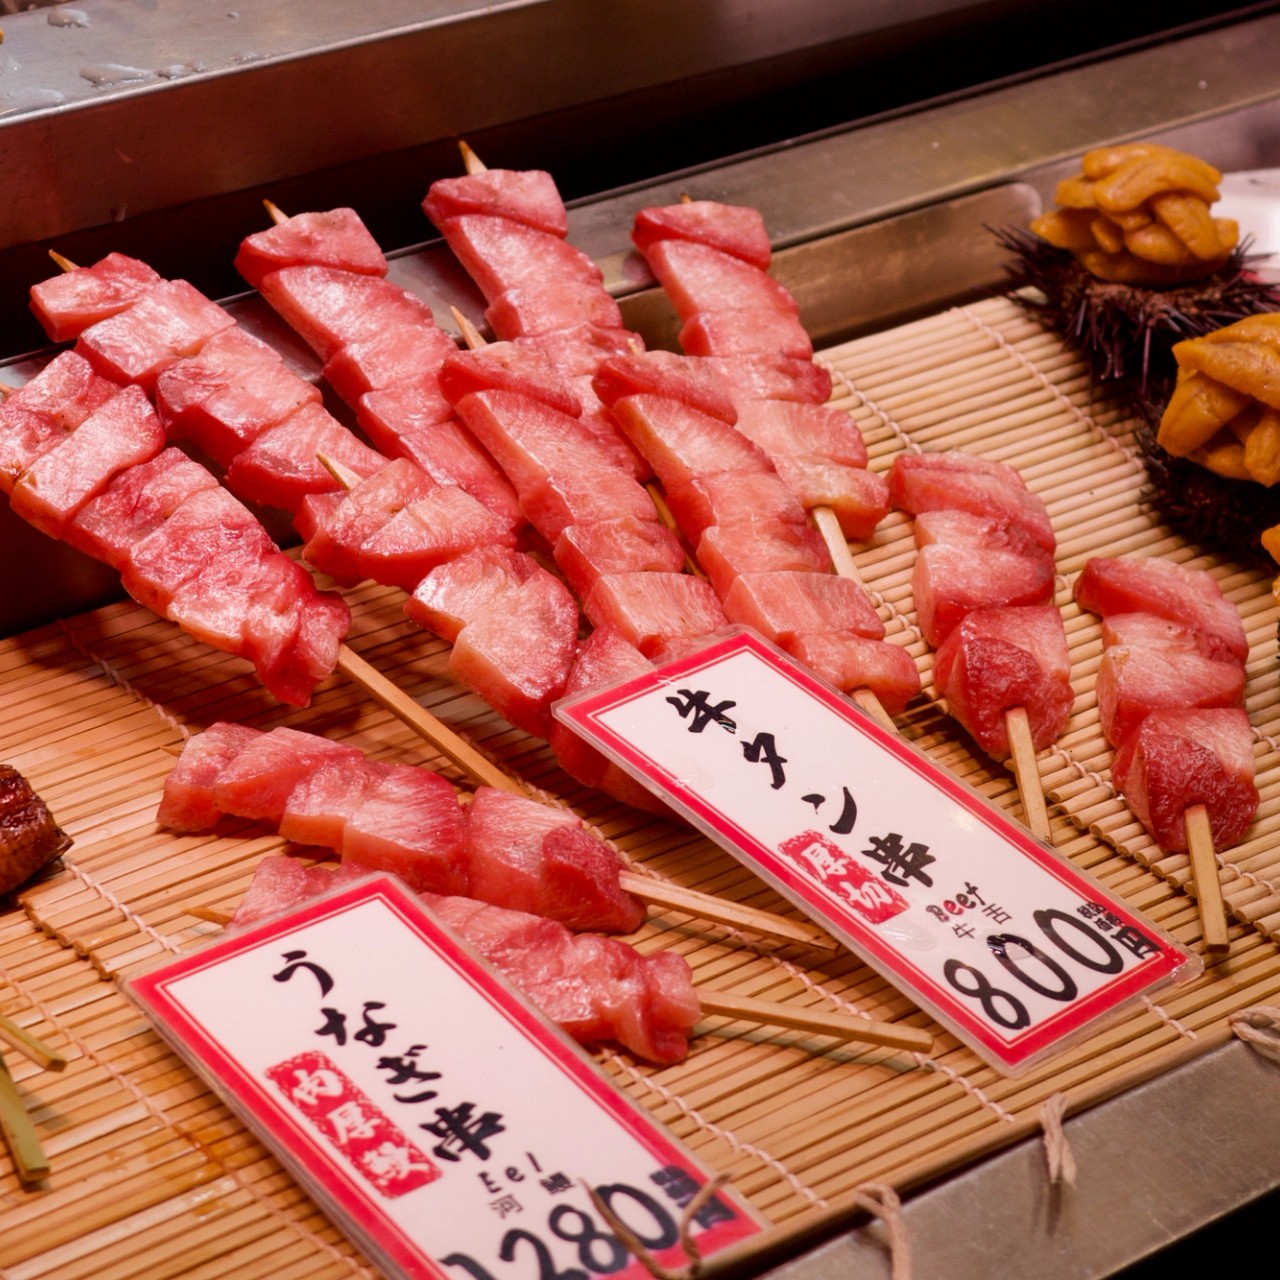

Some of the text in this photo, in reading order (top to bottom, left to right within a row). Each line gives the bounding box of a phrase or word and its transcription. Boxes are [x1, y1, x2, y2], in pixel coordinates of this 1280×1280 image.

[665, 689, 936, 888] 牛タン串
[801, 841, 893, 910] 厚切
[273, 950, 506, 1162] うなぎ串
[478, 1151, 543, 1194] Eel
